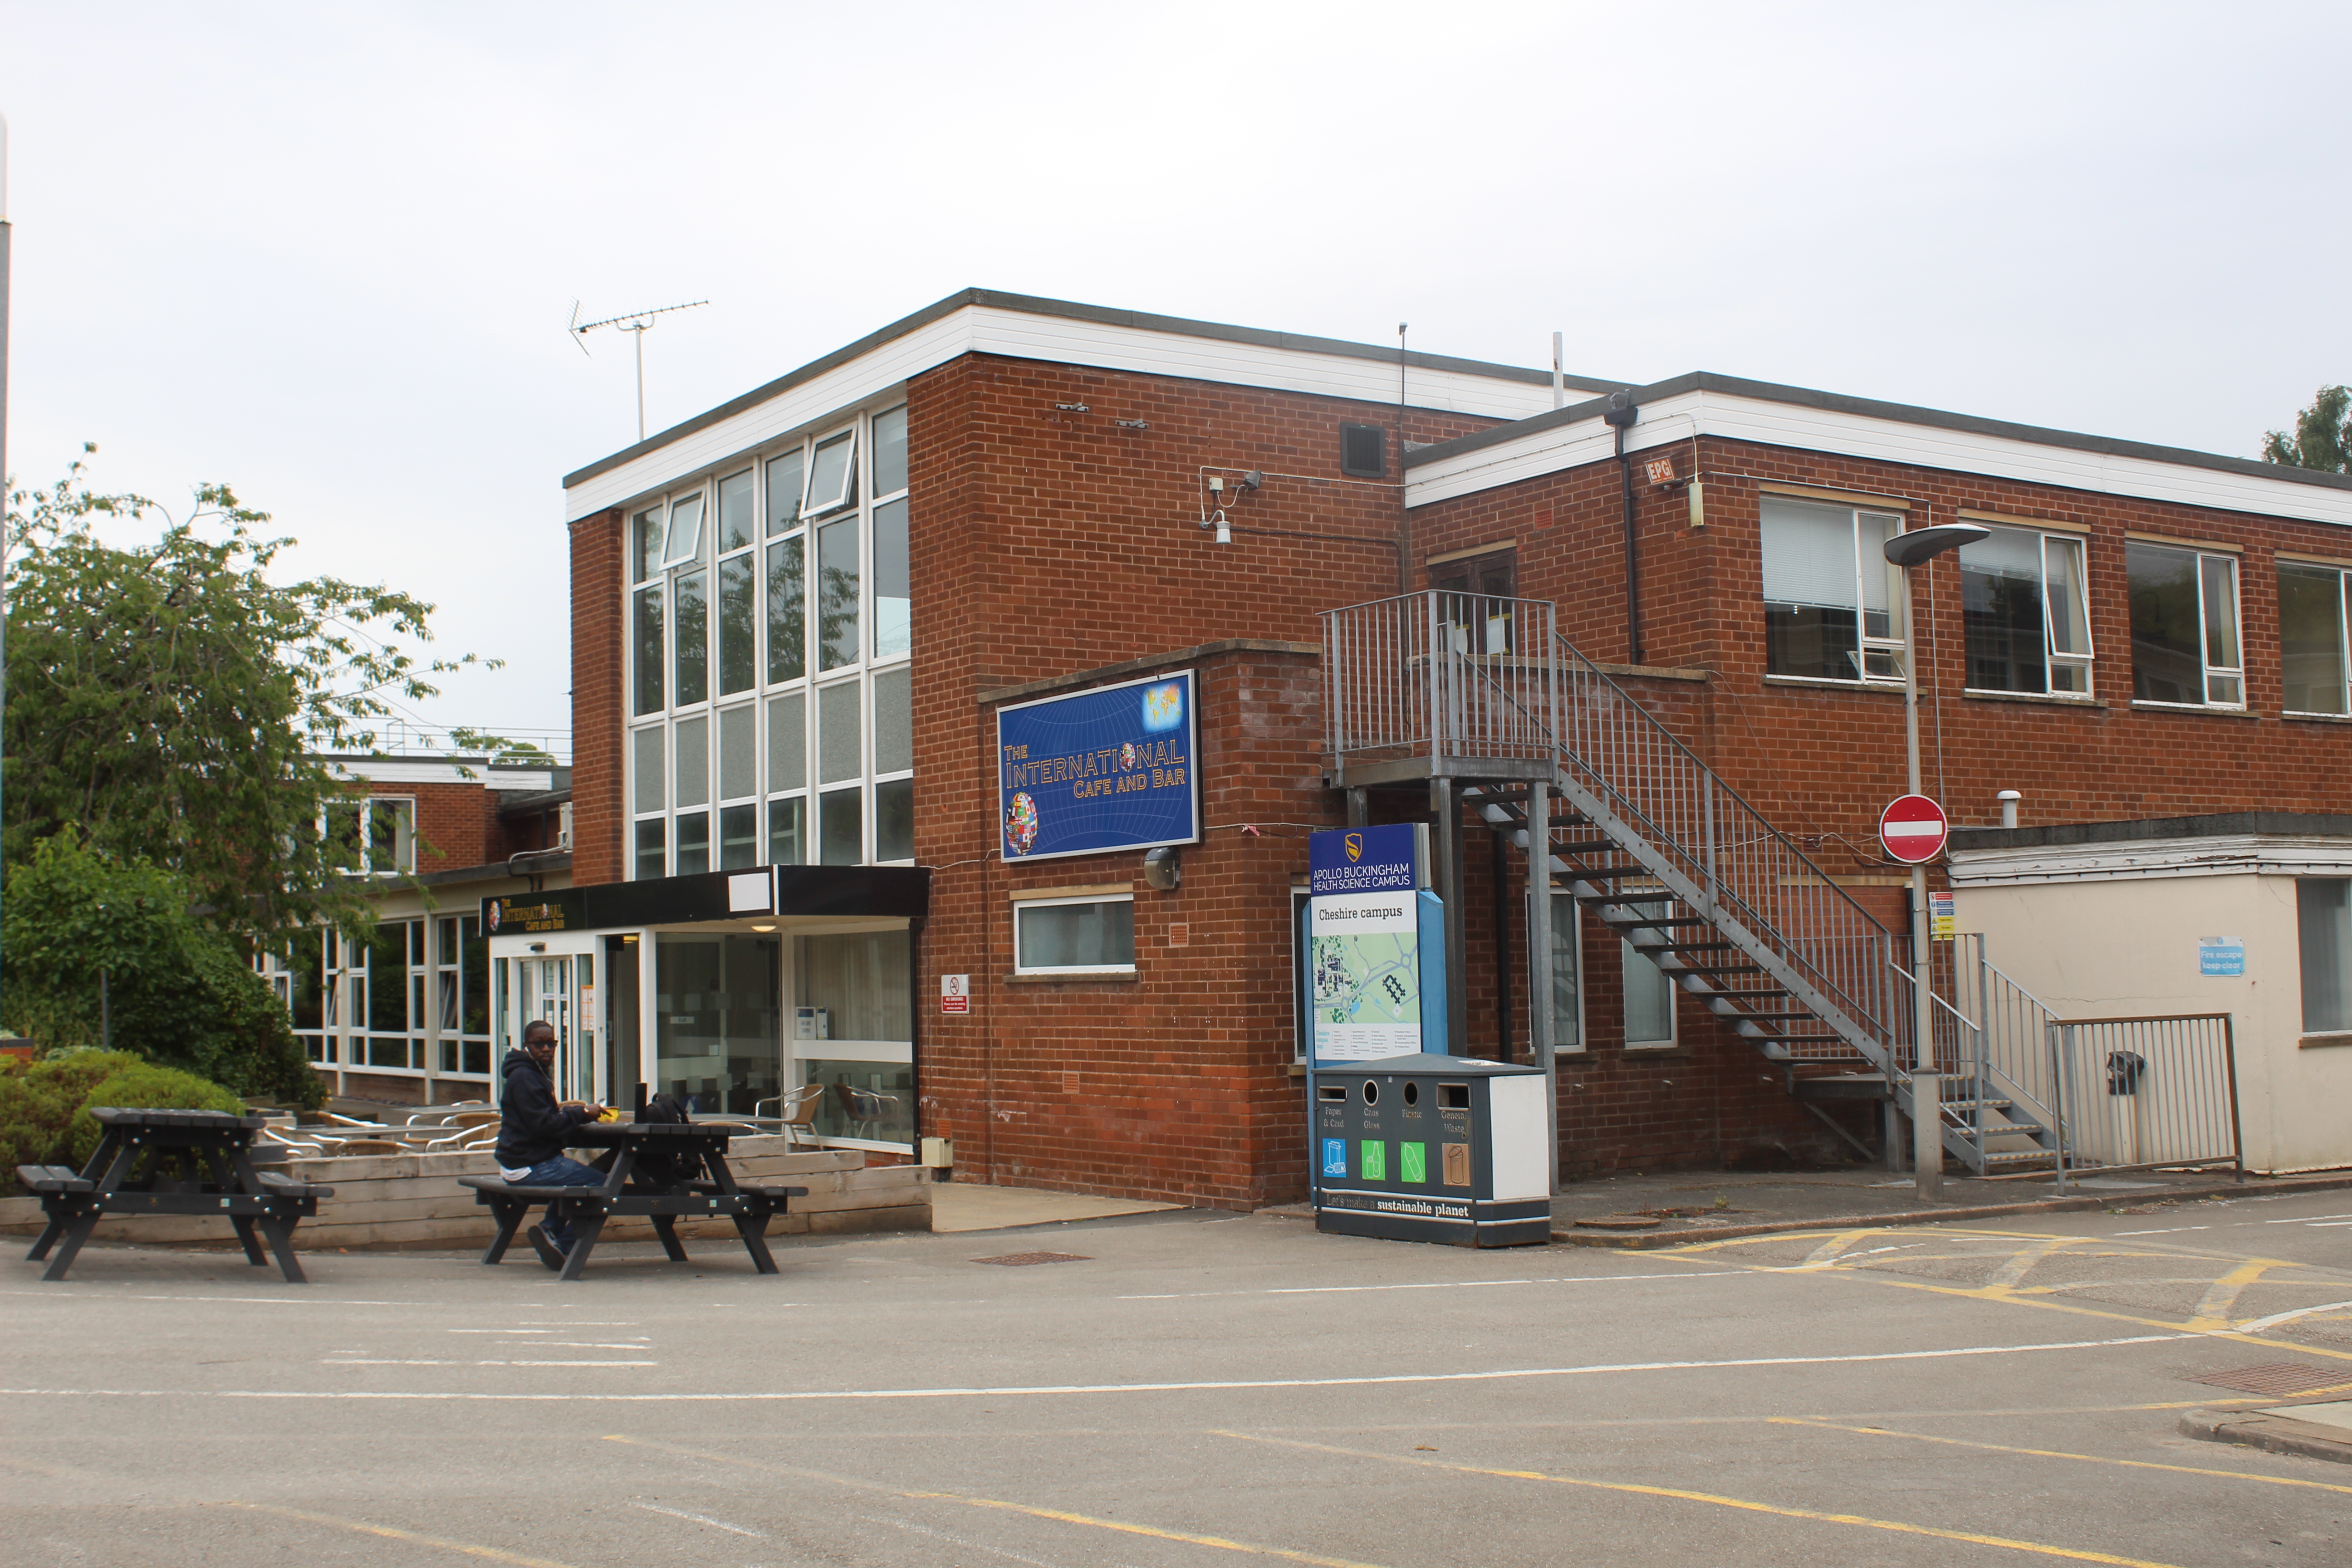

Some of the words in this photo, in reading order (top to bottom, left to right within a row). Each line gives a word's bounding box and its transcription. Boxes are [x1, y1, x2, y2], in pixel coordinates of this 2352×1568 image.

[1648, 460, 1671, 479] EPG
[1073, 778, 1112, 799] CAFE
[1116, 774, 1147, 793] AND
[1153, 768, 1186, 788] BAR
[1313, 867, 1342, 881] APOLLO
[1344, 862, 1409, 878] BUCKINGHAM
[1314, 880, 1338, 891] HEALTH
[1339, 877, 1371, 889] SCIENCE
[1372, 875, 1410, 887] CAMPUS
[1319, 907, 1357, 921] Cheshire
[1361, 907, 1402, 920] campus
[2203, 962, 2221, 970] keep
[1325, 1107, 1342, 1116] Paper
[1364, 1108, 1379, 1116] Cans
[1402, 1109, 1422, 1118] Plastic
[1323, 1118, 1328, 1127] &
[1330, 1119, 1344, 1127] Card
[1364, 1120, 1380, 1129] Glass
[1444, 1123, 1464, 1132] Waste
[1347, 1197, 1367, 1209] make
[1370, 1200, 1375, 1209] a
[1377, 1200, 1432, 1214] sustainable
[1435, 1203, 1469, 1217] planet
